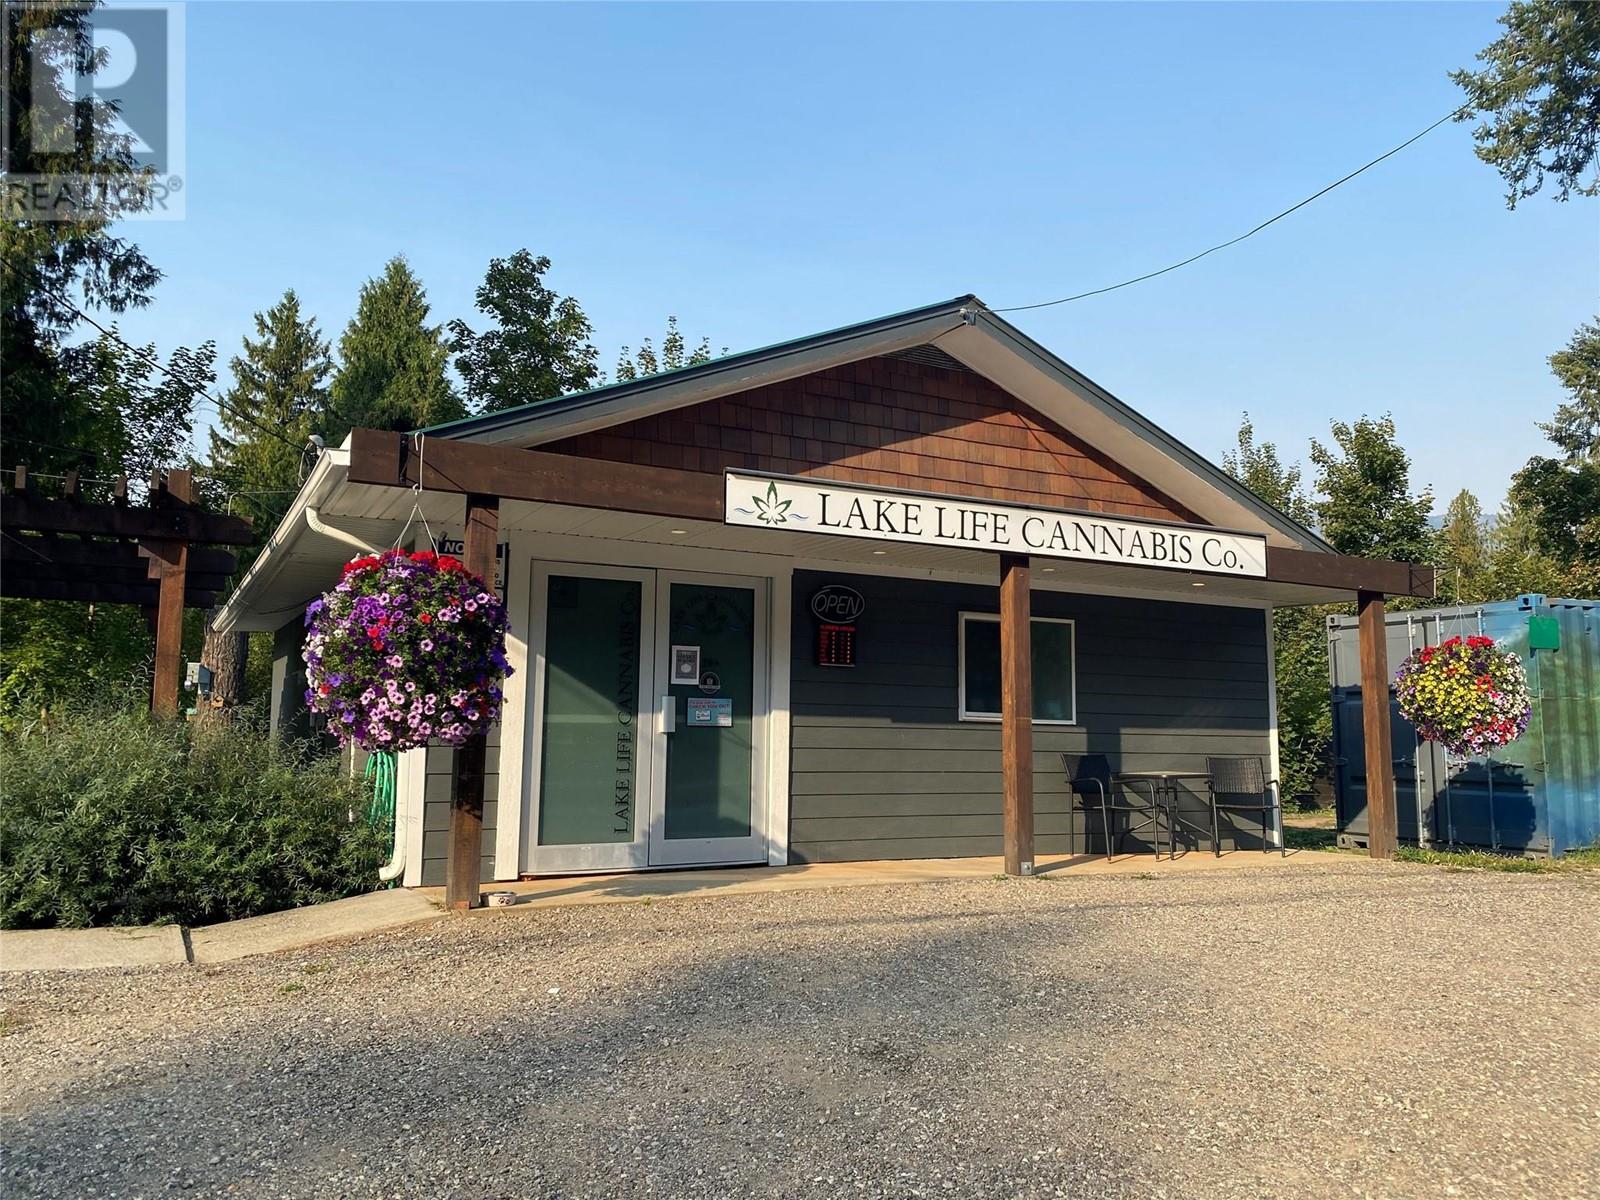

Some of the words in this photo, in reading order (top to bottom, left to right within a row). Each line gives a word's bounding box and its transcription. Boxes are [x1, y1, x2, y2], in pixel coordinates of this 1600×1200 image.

[817, 493, 923, 536] LAKE
[934, 506, 1011, 545] LIFE
[1021, 517, 1193, 564] CANNABIS
[1202, 538, 1244, 570] Co.
[815, 594, 861, 615] OPEN
[616, 731, 633, 774] LIFE
[614, 779, 631, 834] LAKE
